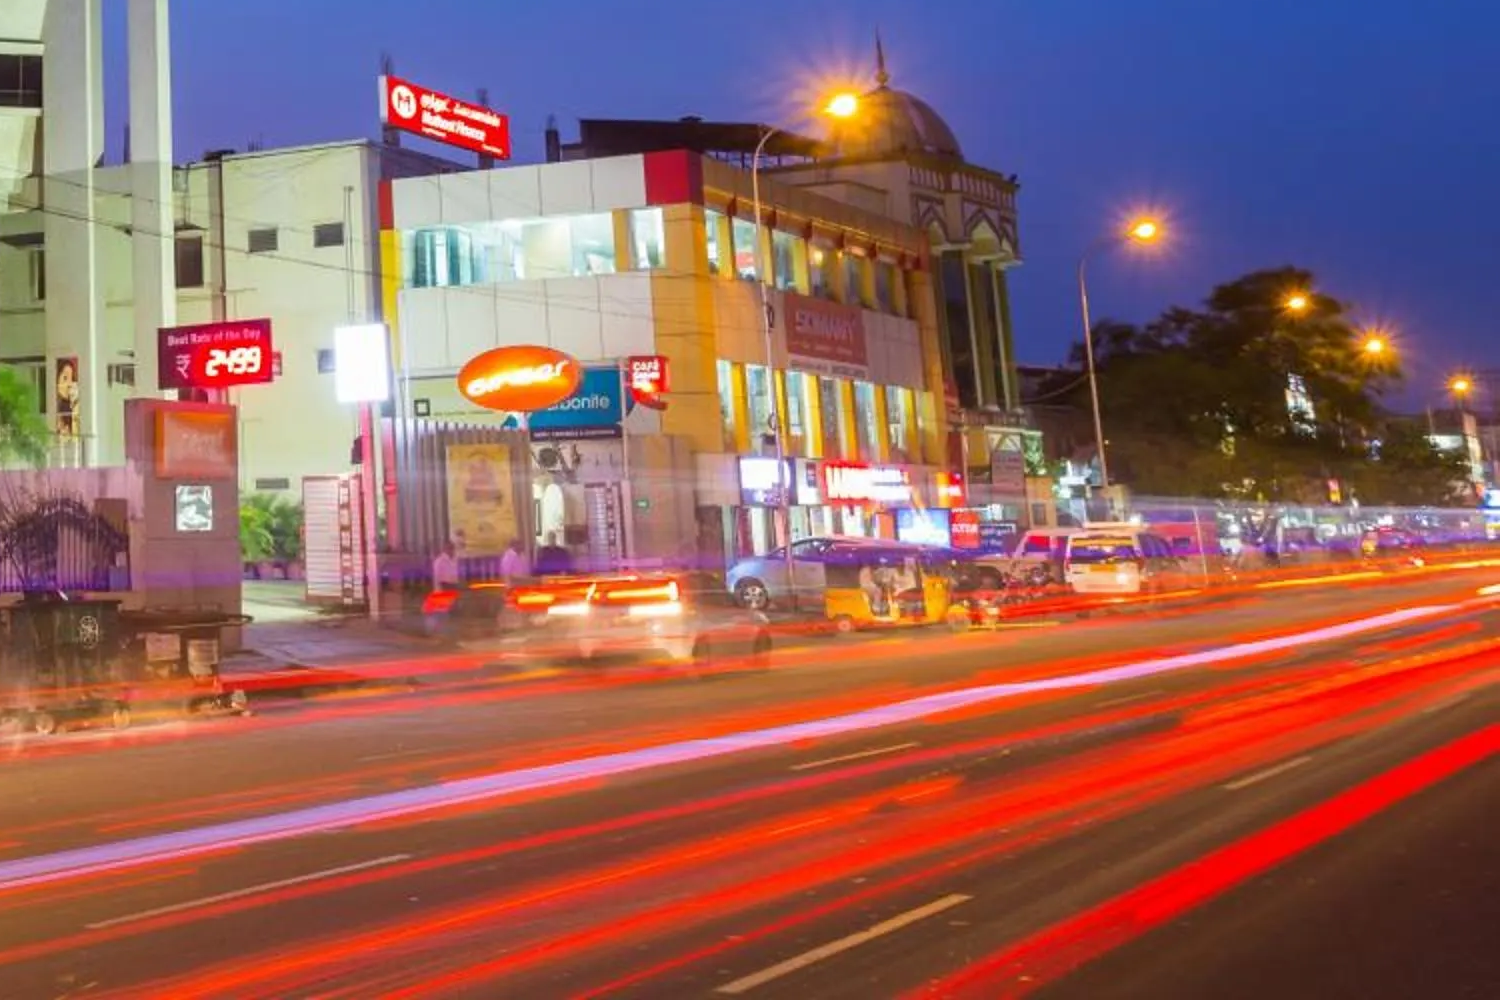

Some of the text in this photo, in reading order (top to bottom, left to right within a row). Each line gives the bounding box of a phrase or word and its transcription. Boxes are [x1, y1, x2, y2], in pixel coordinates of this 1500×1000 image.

[167, 328, 260, 346] Best Rate of the Day
[205, 346, 261, 377] 2499
